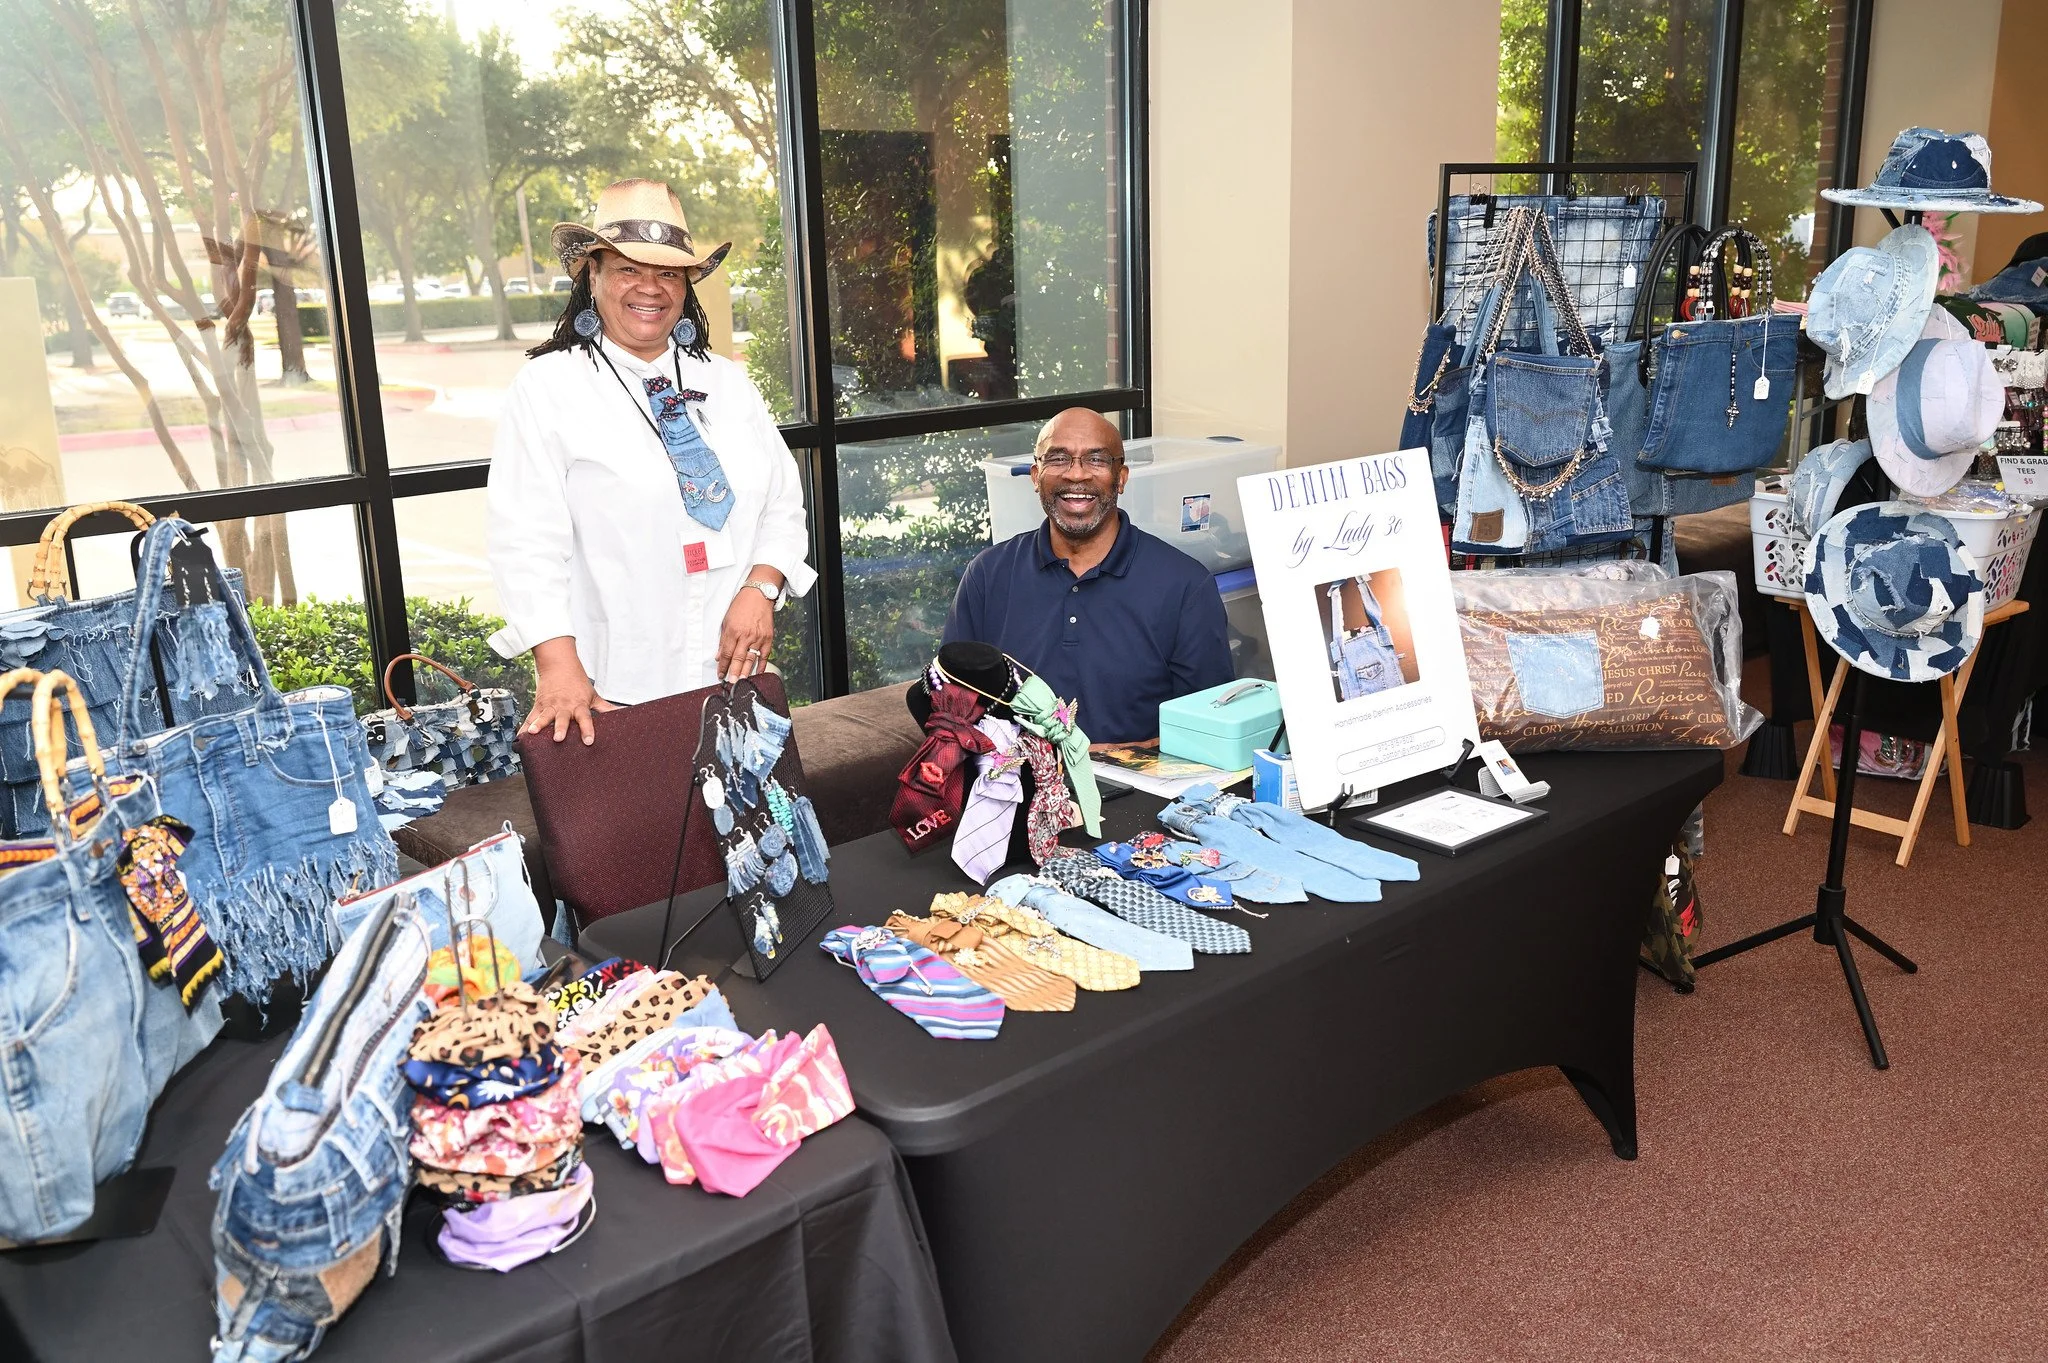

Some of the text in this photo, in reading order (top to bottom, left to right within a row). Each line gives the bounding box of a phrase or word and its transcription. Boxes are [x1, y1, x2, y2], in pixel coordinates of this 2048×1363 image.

[2000, 457, 2019, 465] FIND
[2026, 458, 2048, 466] GRAB
[2016, 467, 2037, 475] TEES
[1268, 455, 1407, 512] DENIM BAGS
[2023, 477, 2034, 485] $5
[1286, 525, 1316, 569] by
[1323, 510, 1375, 557] Lady
[1544, 616, 1598, 629] WISDOM
[1603, 663, 1678, 681] JESUS CHRIST
[1629, 678, 1708, 714] Rejoice
[1621, 713, 1651, 723] LORD
[1523, 723, 1566, 737] GLORY
[1599, 722, 1665, 735] SALVATION
[906, 809, 952, 841] LOVE
